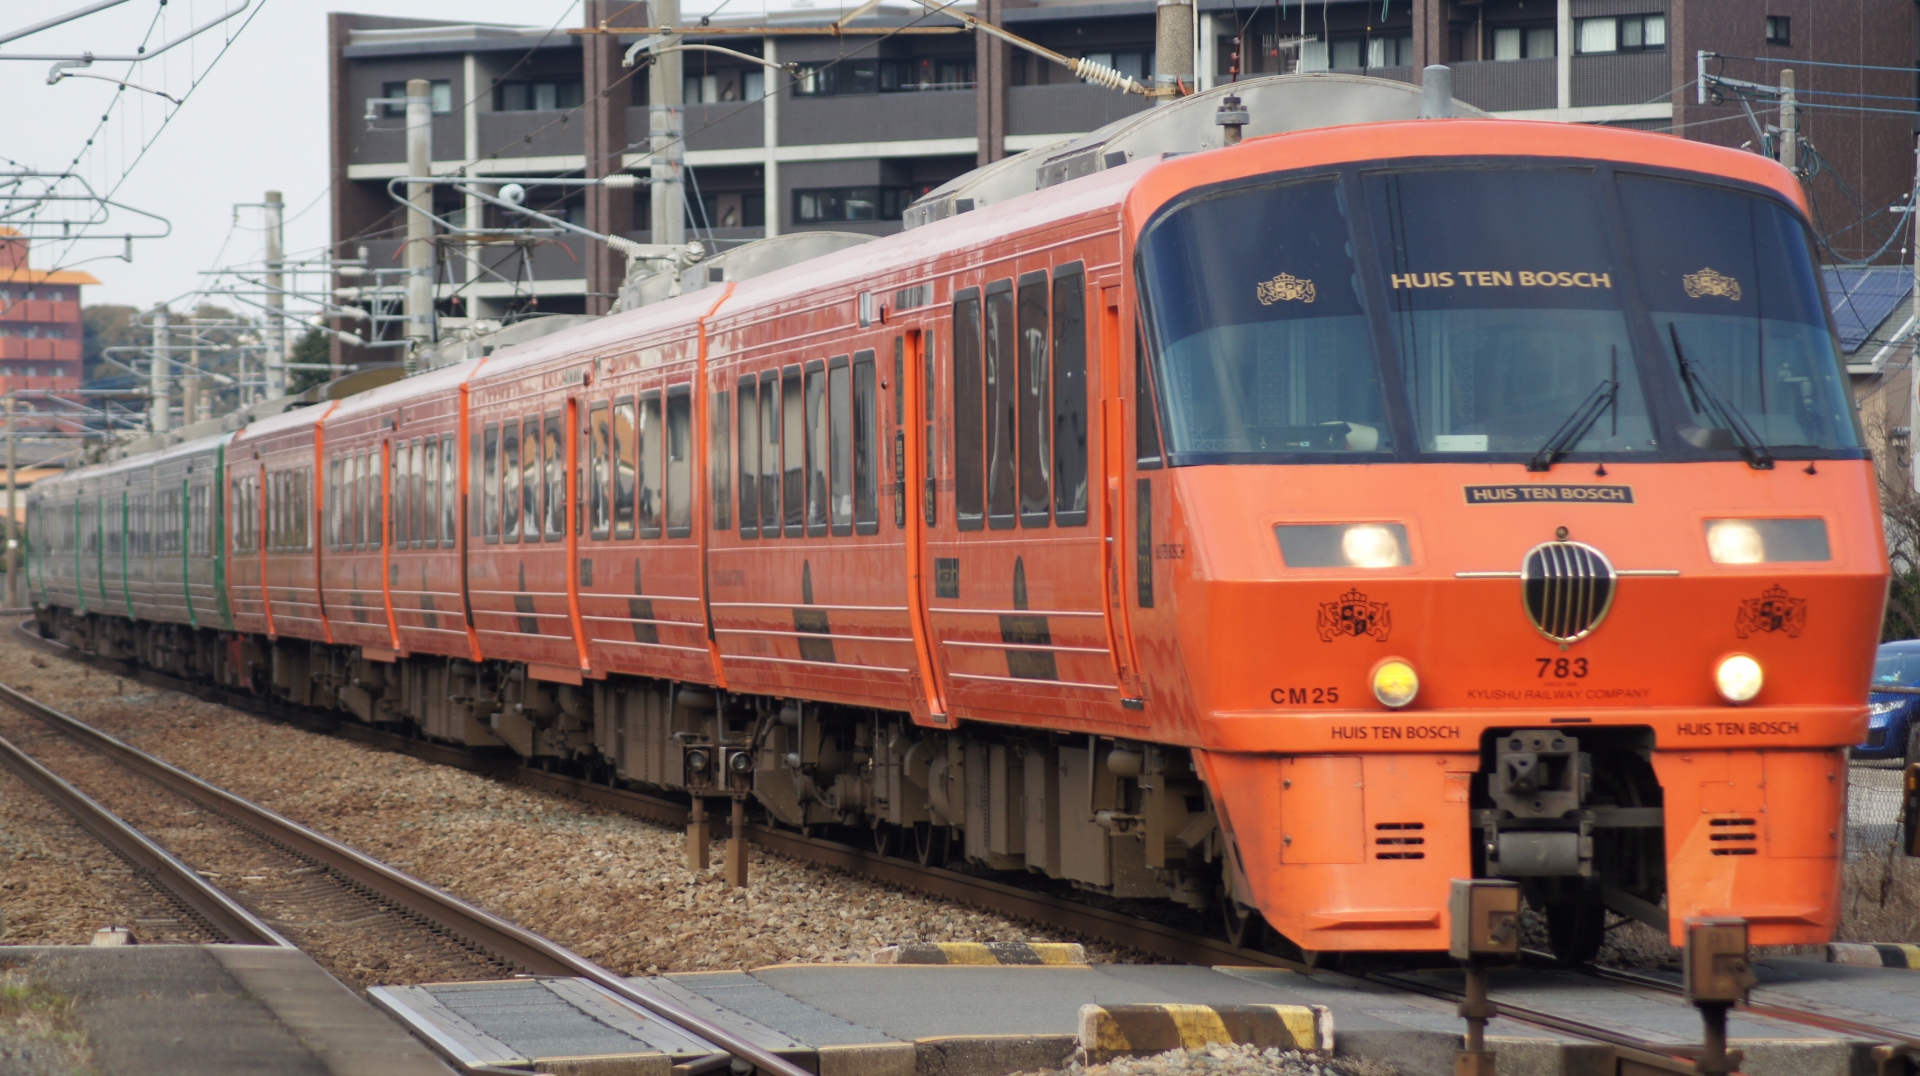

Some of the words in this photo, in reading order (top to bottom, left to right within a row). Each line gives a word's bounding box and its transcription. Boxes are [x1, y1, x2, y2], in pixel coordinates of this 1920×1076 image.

[1391, 272, 1454, 288] HUIS
[1458, 271, 1513, 286] TEN
[1518, 271, 1611, 288] BOSCH
[1473, 488, 1518, 500] HUIS
[1519, 488, 1558, 499] TEN
[1561, 488, 1625, 499] BOSCH
[1535, 657, 1589, 678] 783
[1467, 690, 1522, 700] KYUSHU
[1525, 690, 1583, 700] RAILWAY
[1586, 689, 1650, 699] COMPANY
[1331, 726, 1368, 739] HUIS
[1371, 726, 1403, 738] TEN
[1406, 726, 1460, 739] BOSCH
[1677, 722, 1712, 735] HUIS
[1715, 722, 1745, 735] TEN
[1748, 721, 1799, 735] BOSCH
